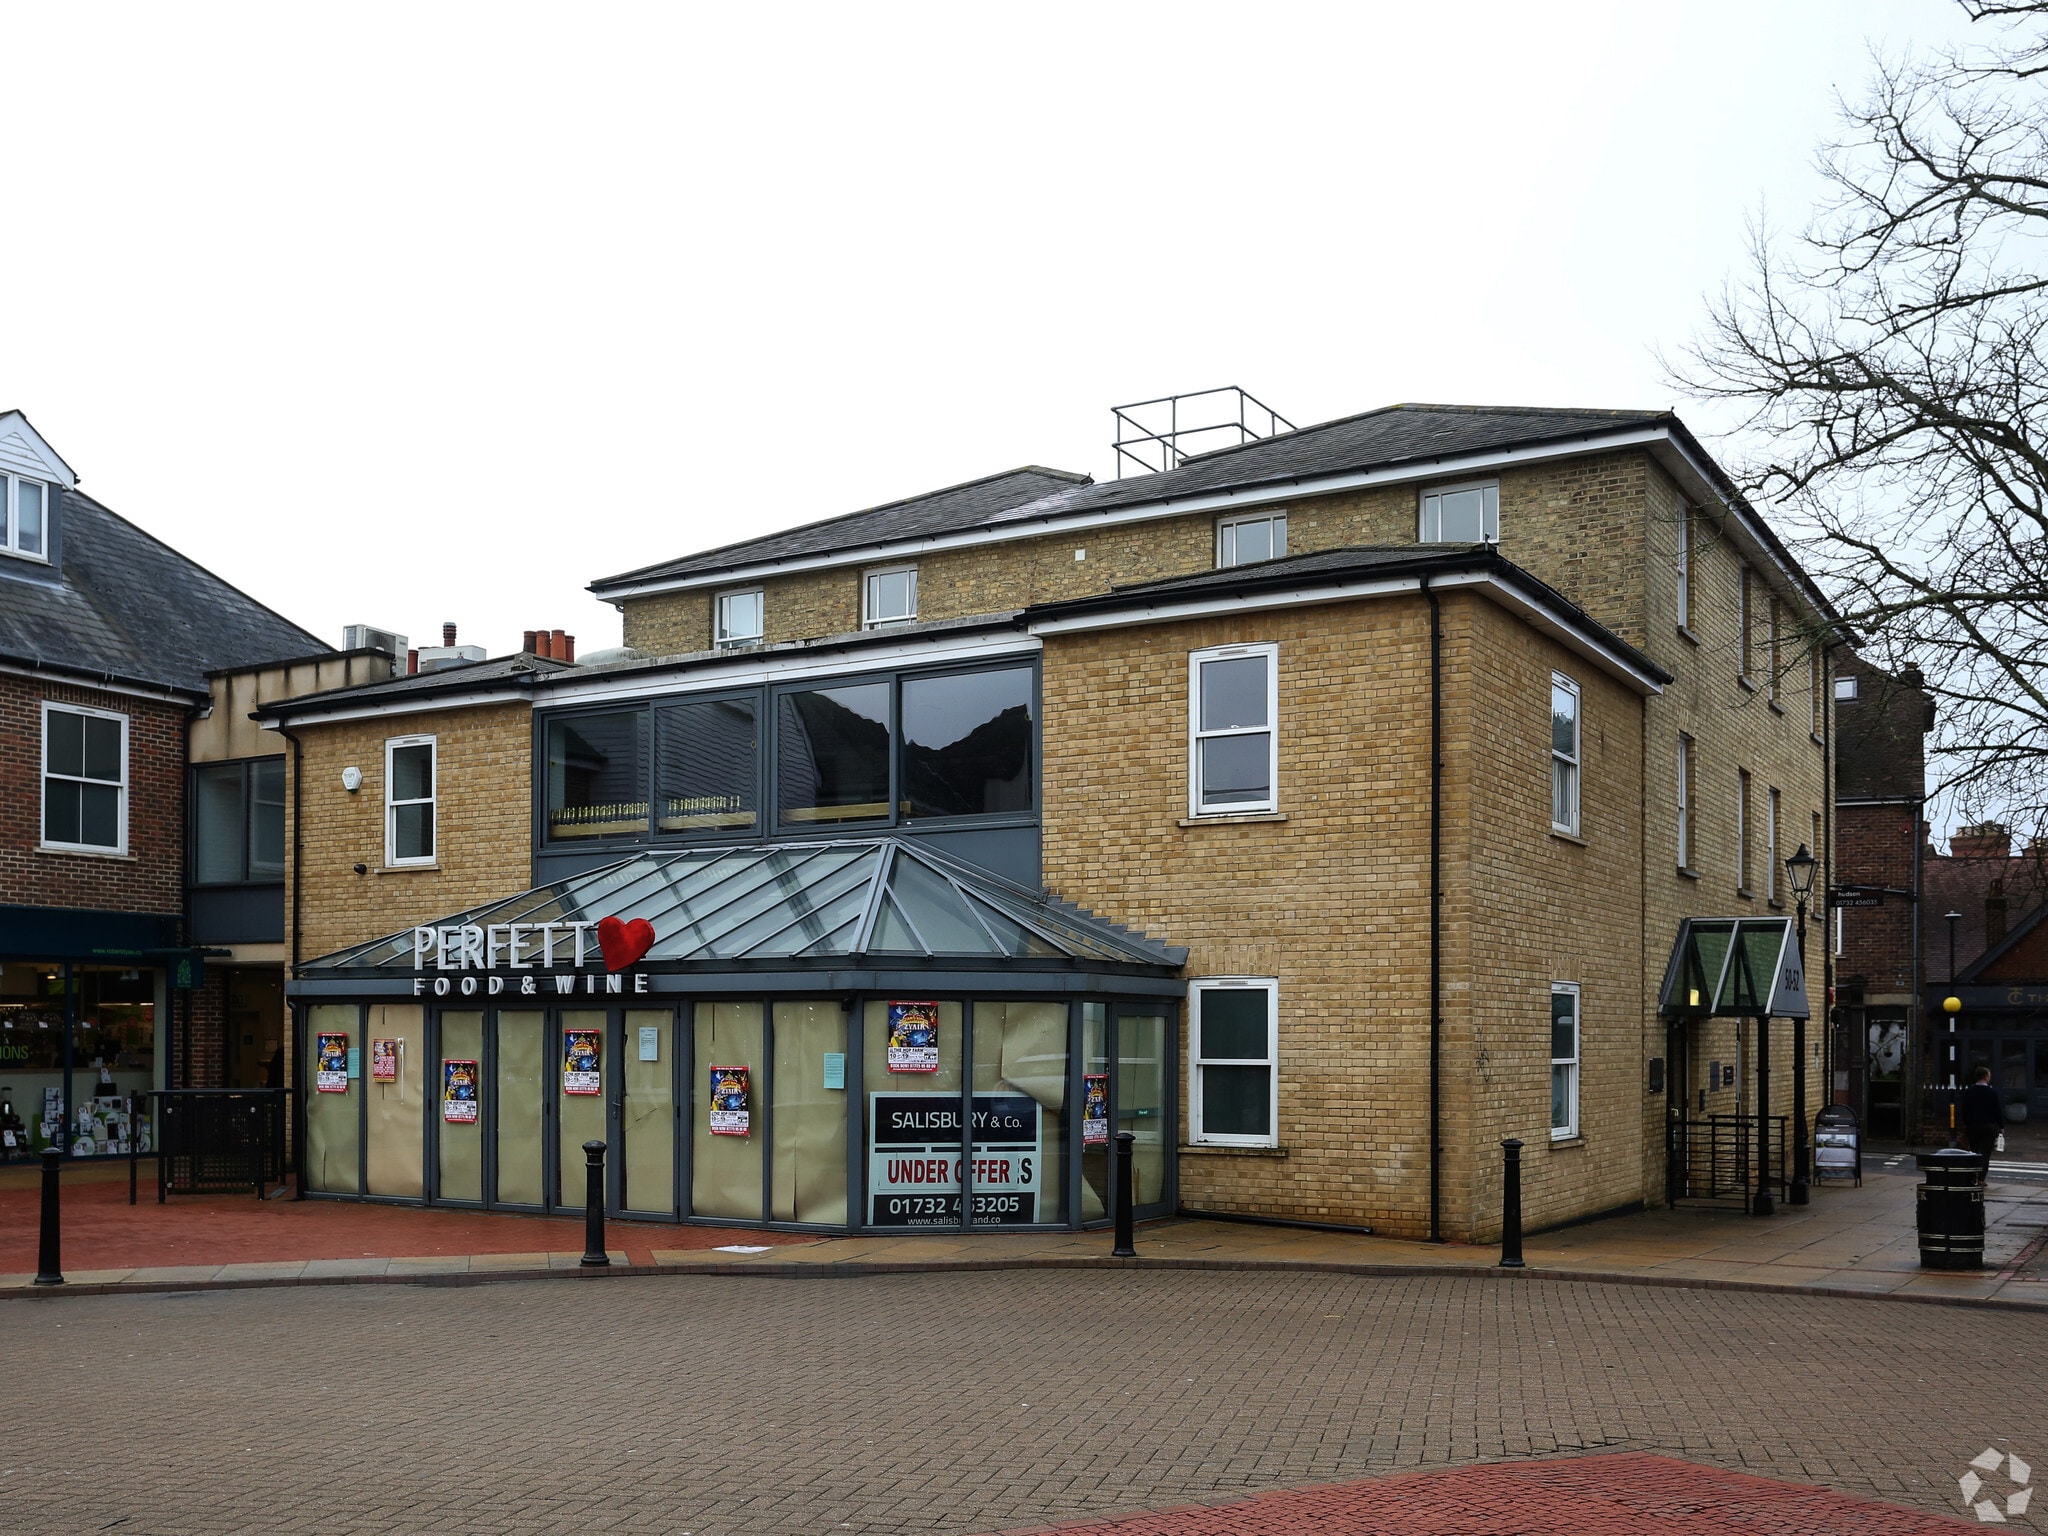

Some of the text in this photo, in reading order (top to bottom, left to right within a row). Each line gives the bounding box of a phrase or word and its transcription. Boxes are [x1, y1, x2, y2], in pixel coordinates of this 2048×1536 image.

[414, 920, 595, 971] PERFETT
[413, 973, 648, 996] FOOD & WINE
[990, 1115, 1001, 1129] &
[1004, 1115, 1022, 1129] Co.
[888, 1159, 949, 1184] UNDER
[889, 1198, 946, 1215] 01732
